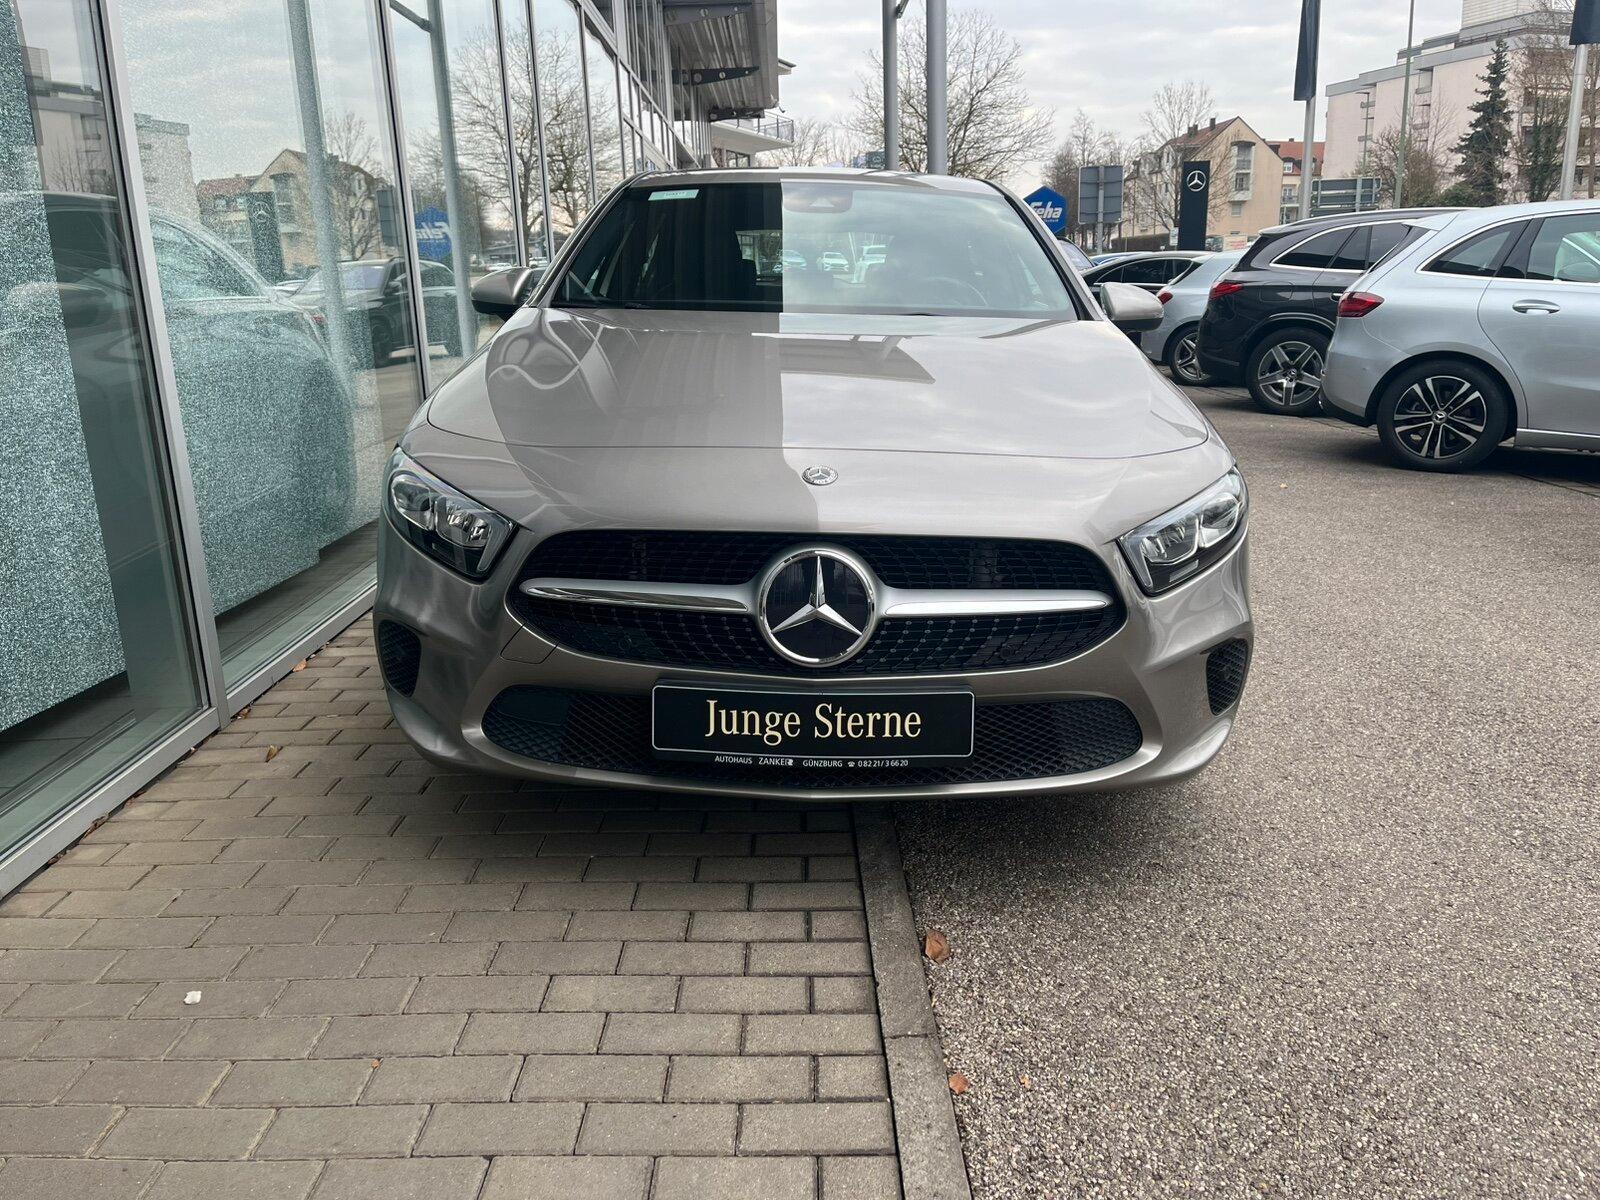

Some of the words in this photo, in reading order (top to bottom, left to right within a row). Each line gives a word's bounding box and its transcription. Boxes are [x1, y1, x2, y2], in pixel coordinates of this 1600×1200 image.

[705, 700, 800, 746] Junge
[814, 703, 921, 739] Sterne
[714, 755, 753, 765] AUTOHAUS
[802, 759, 843, 767] GÜNZBURG
